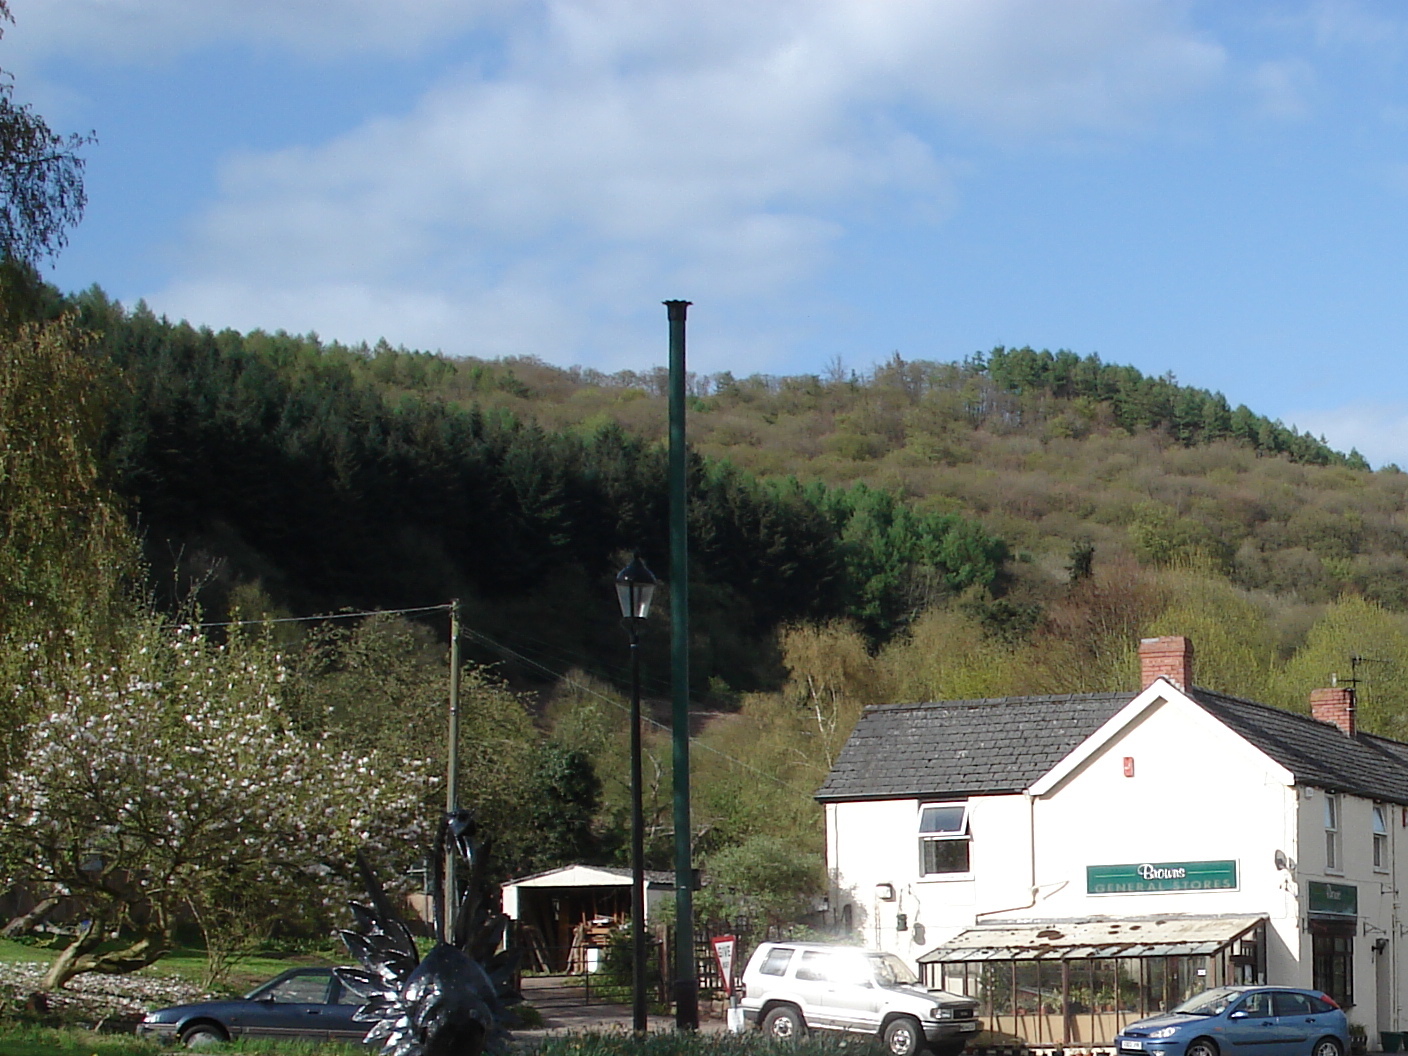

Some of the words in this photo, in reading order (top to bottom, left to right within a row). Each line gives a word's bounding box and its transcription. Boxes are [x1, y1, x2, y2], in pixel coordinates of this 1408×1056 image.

[1137, 863, 1186, 881] Browns
[1095, 881, 1165, 893] GENERAL
[1172, 879, 1231, 890] STORES
